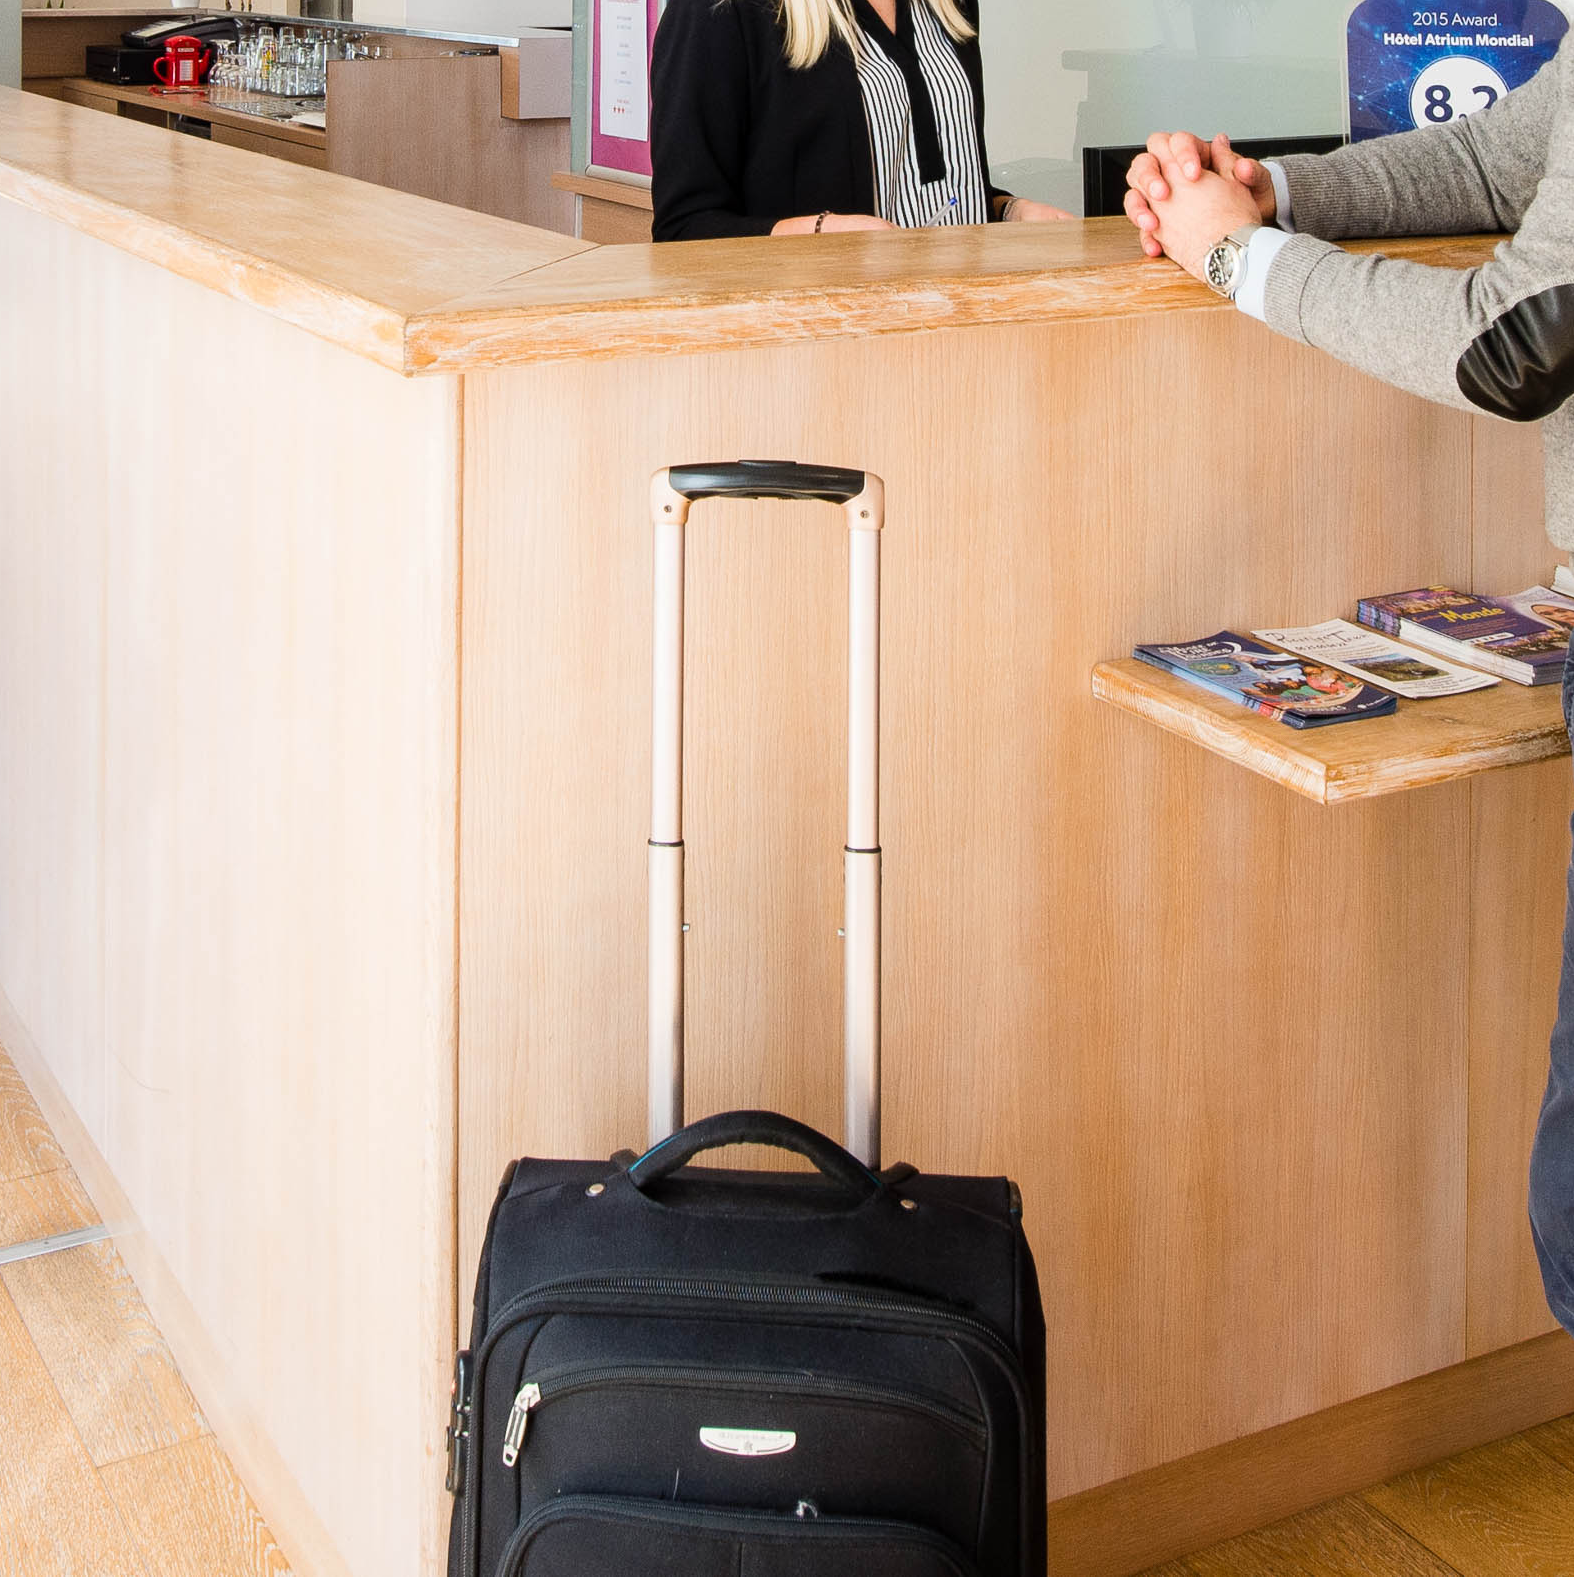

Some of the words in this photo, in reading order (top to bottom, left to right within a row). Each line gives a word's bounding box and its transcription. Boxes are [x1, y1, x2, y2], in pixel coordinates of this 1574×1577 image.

[1412, 11, 1449, 26] 2015
[1383, 32, 1423, 46] Hôtel
[1424, 33, 1474, 47] Atrium
[1475, 34, 1535, 48] Mondial
[1438, 606, 1506, 623] Monde
